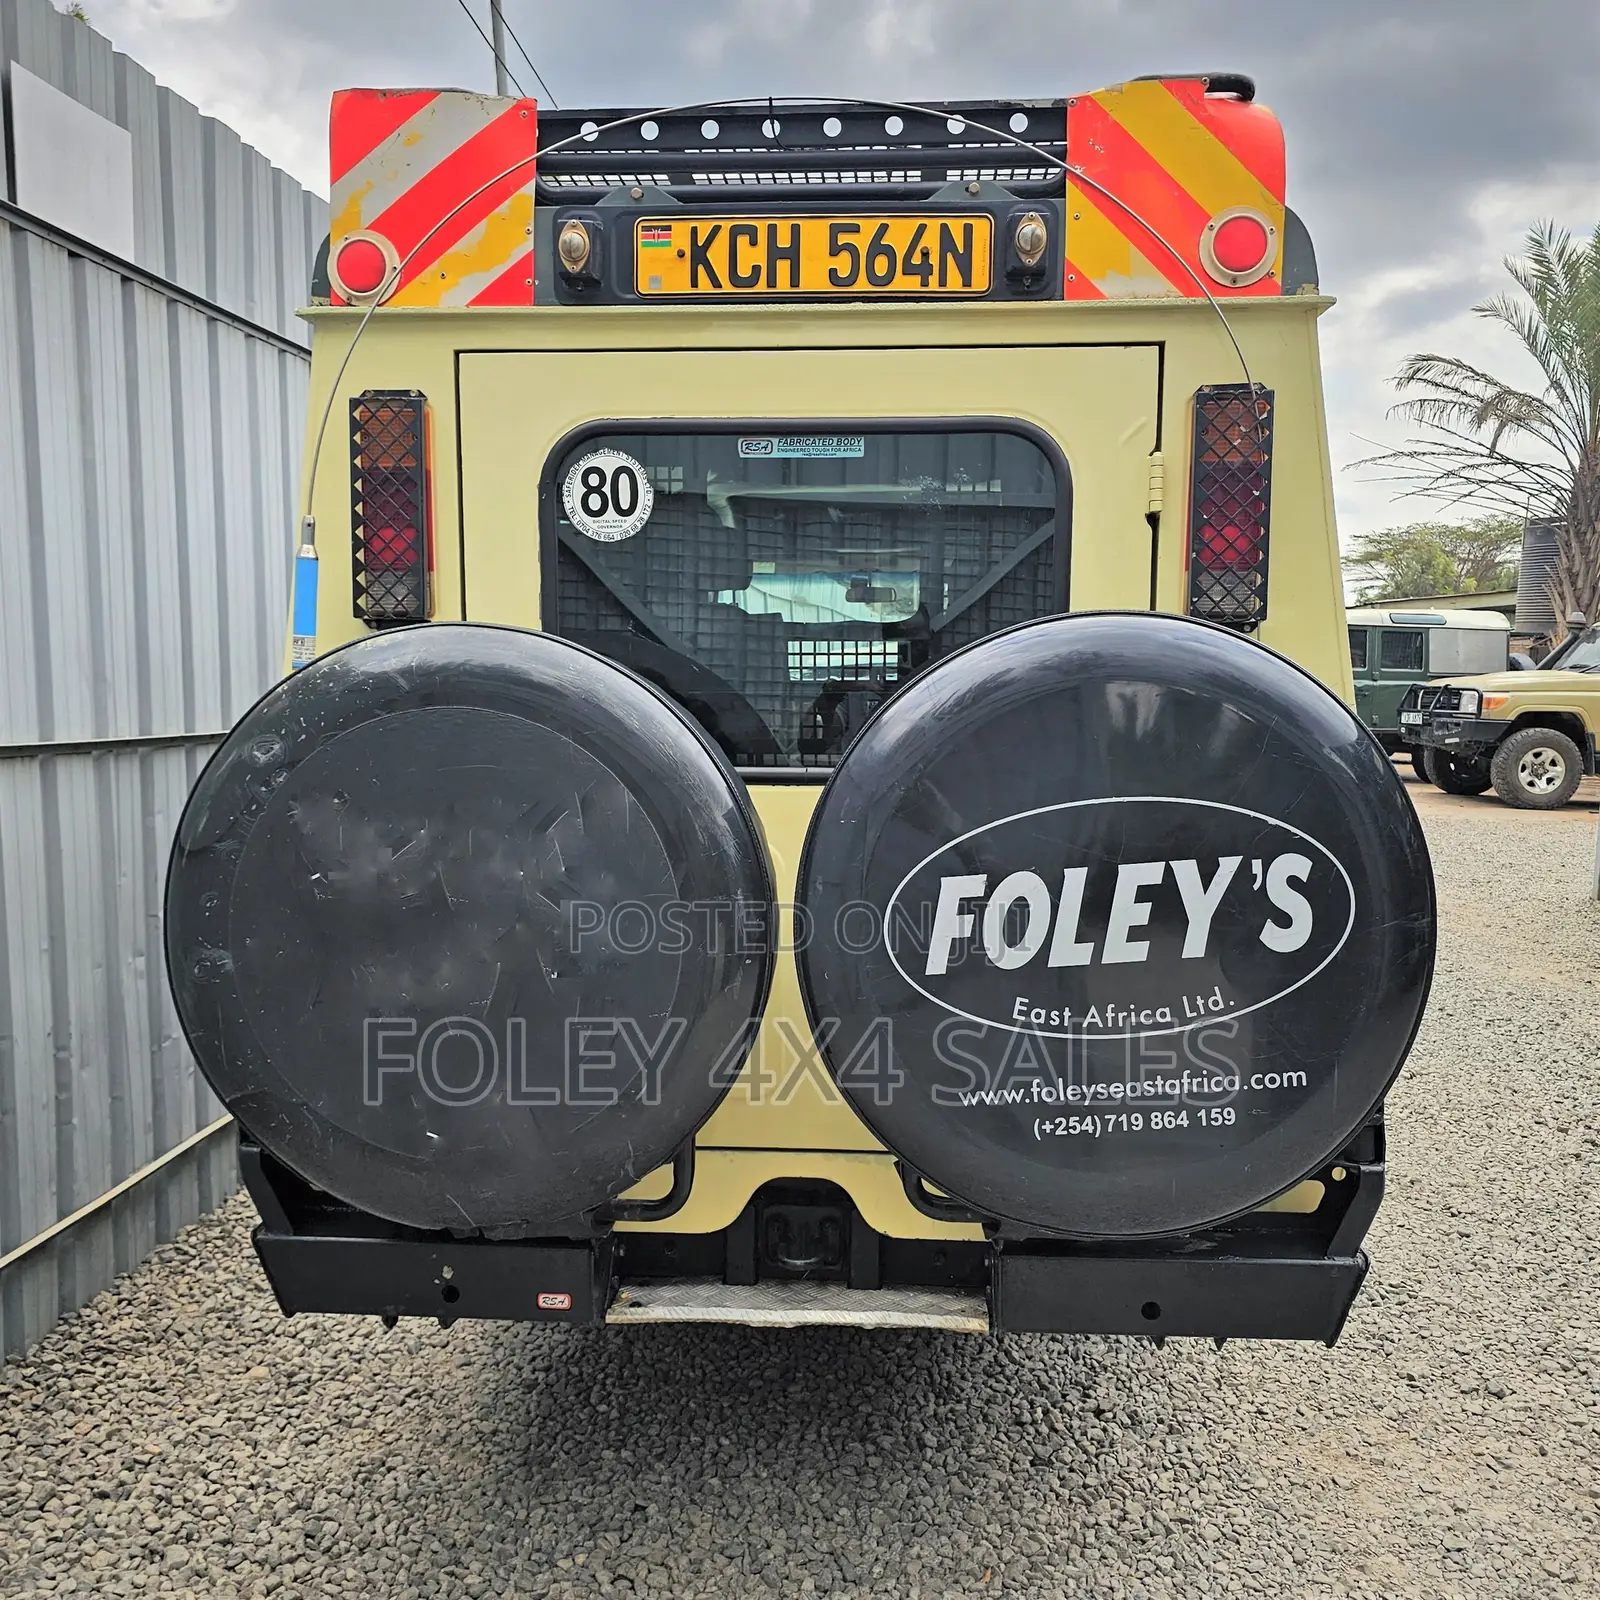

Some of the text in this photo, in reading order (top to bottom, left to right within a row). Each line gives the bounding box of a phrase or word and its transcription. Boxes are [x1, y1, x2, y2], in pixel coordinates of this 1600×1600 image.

[690, 223, 801, 288] KCH
[828, 222, 974, 288] 564N
[777, 437, 862, 446] FABRICATED BODY
[565, 460, 583, 498] SAFERIDER
[580, 465, 639, 518] 80
[575, 519, 590, 534] 0704
[590, 530, 602, 540] 376
[642, 503, 652, 516] 172
[925, 852, 1314, 976] FOLEY'S
[1012, 985, 1236, 1028] East Africa Ltd.
[958, 1068, 1308, 1107] www.foleyseastafrica.com
[1149, 1108, 1190, 1131] 864
[1196, 1106, 1237, 1128] 159
